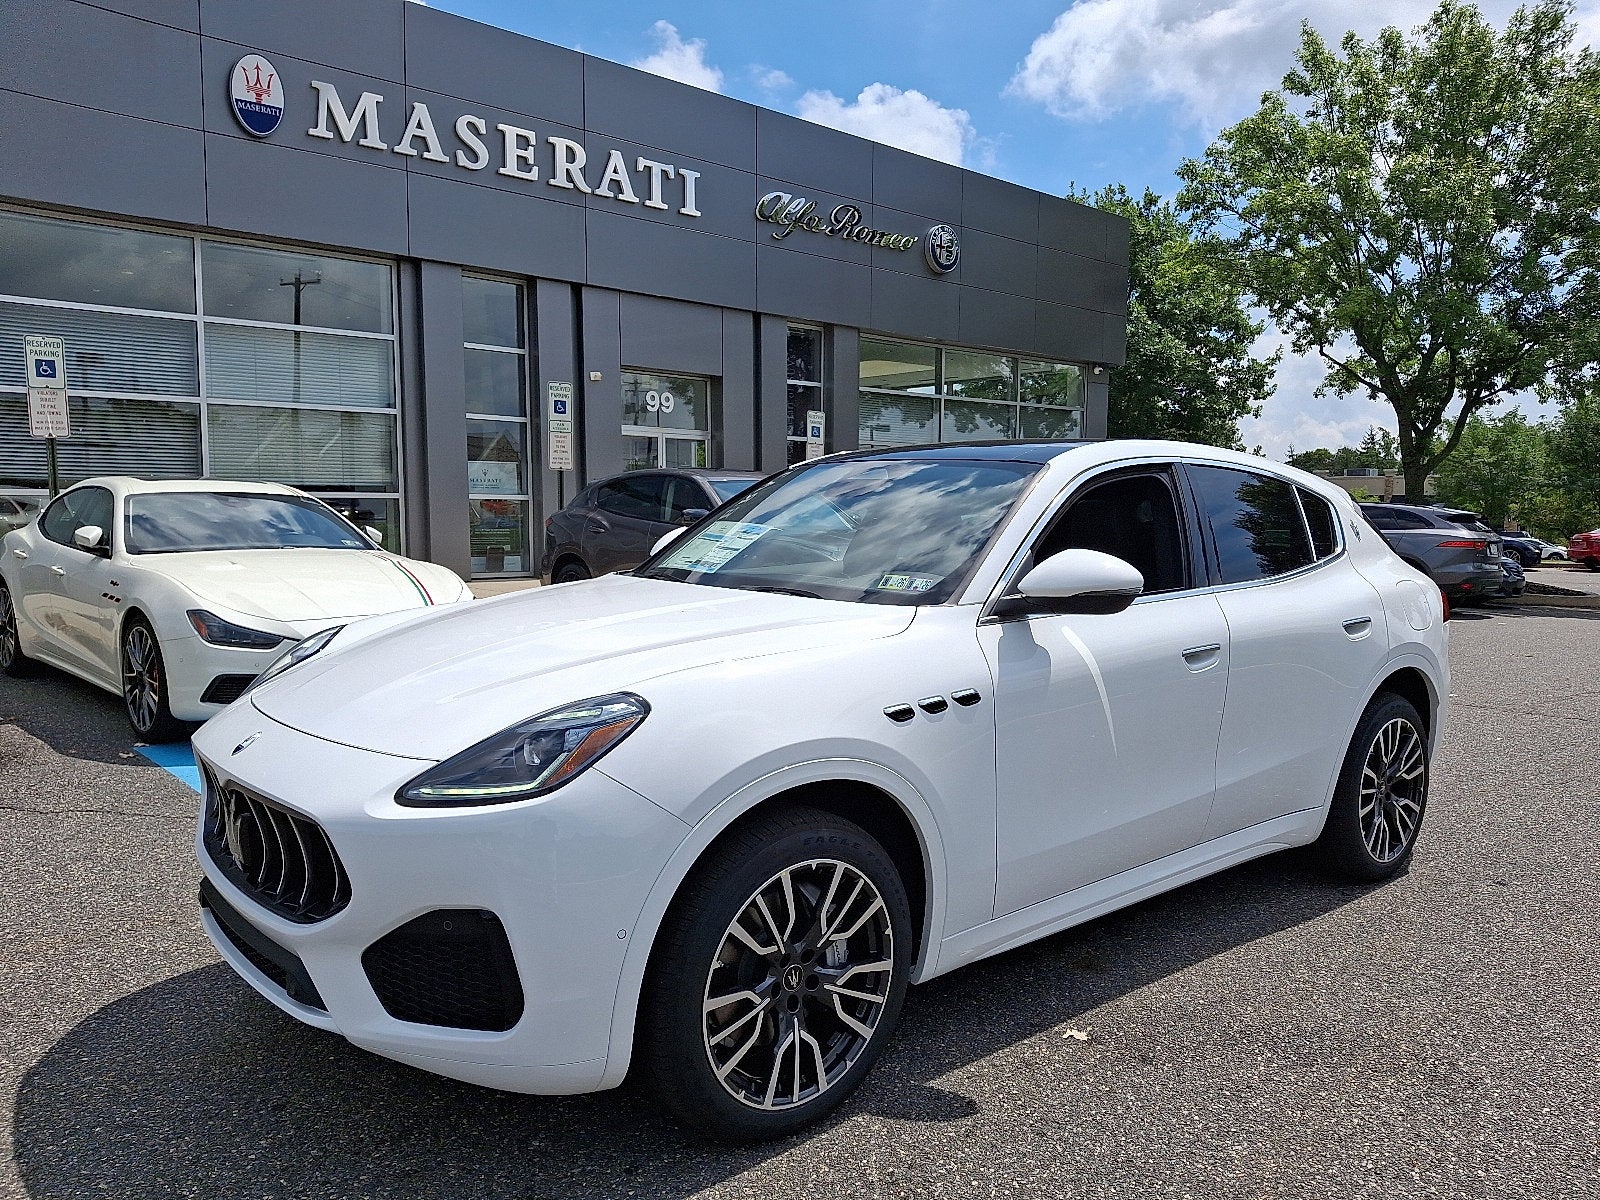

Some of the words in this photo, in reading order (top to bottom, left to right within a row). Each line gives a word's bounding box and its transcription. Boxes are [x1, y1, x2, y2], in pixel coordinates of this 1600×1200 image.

[237, 101, 280, 116] MASERATI
[307, 80, 702, 217] MASERATI
[755, 191, 827, 240] Alfa
[825, 204, 919, 251] Romeo
[26, 340, 61, 349] RESERVED
[29, 349, 60, 358] PARKING
[645, 390, 675, 413] 99
[803, 835, 862, 849] EAGLE
